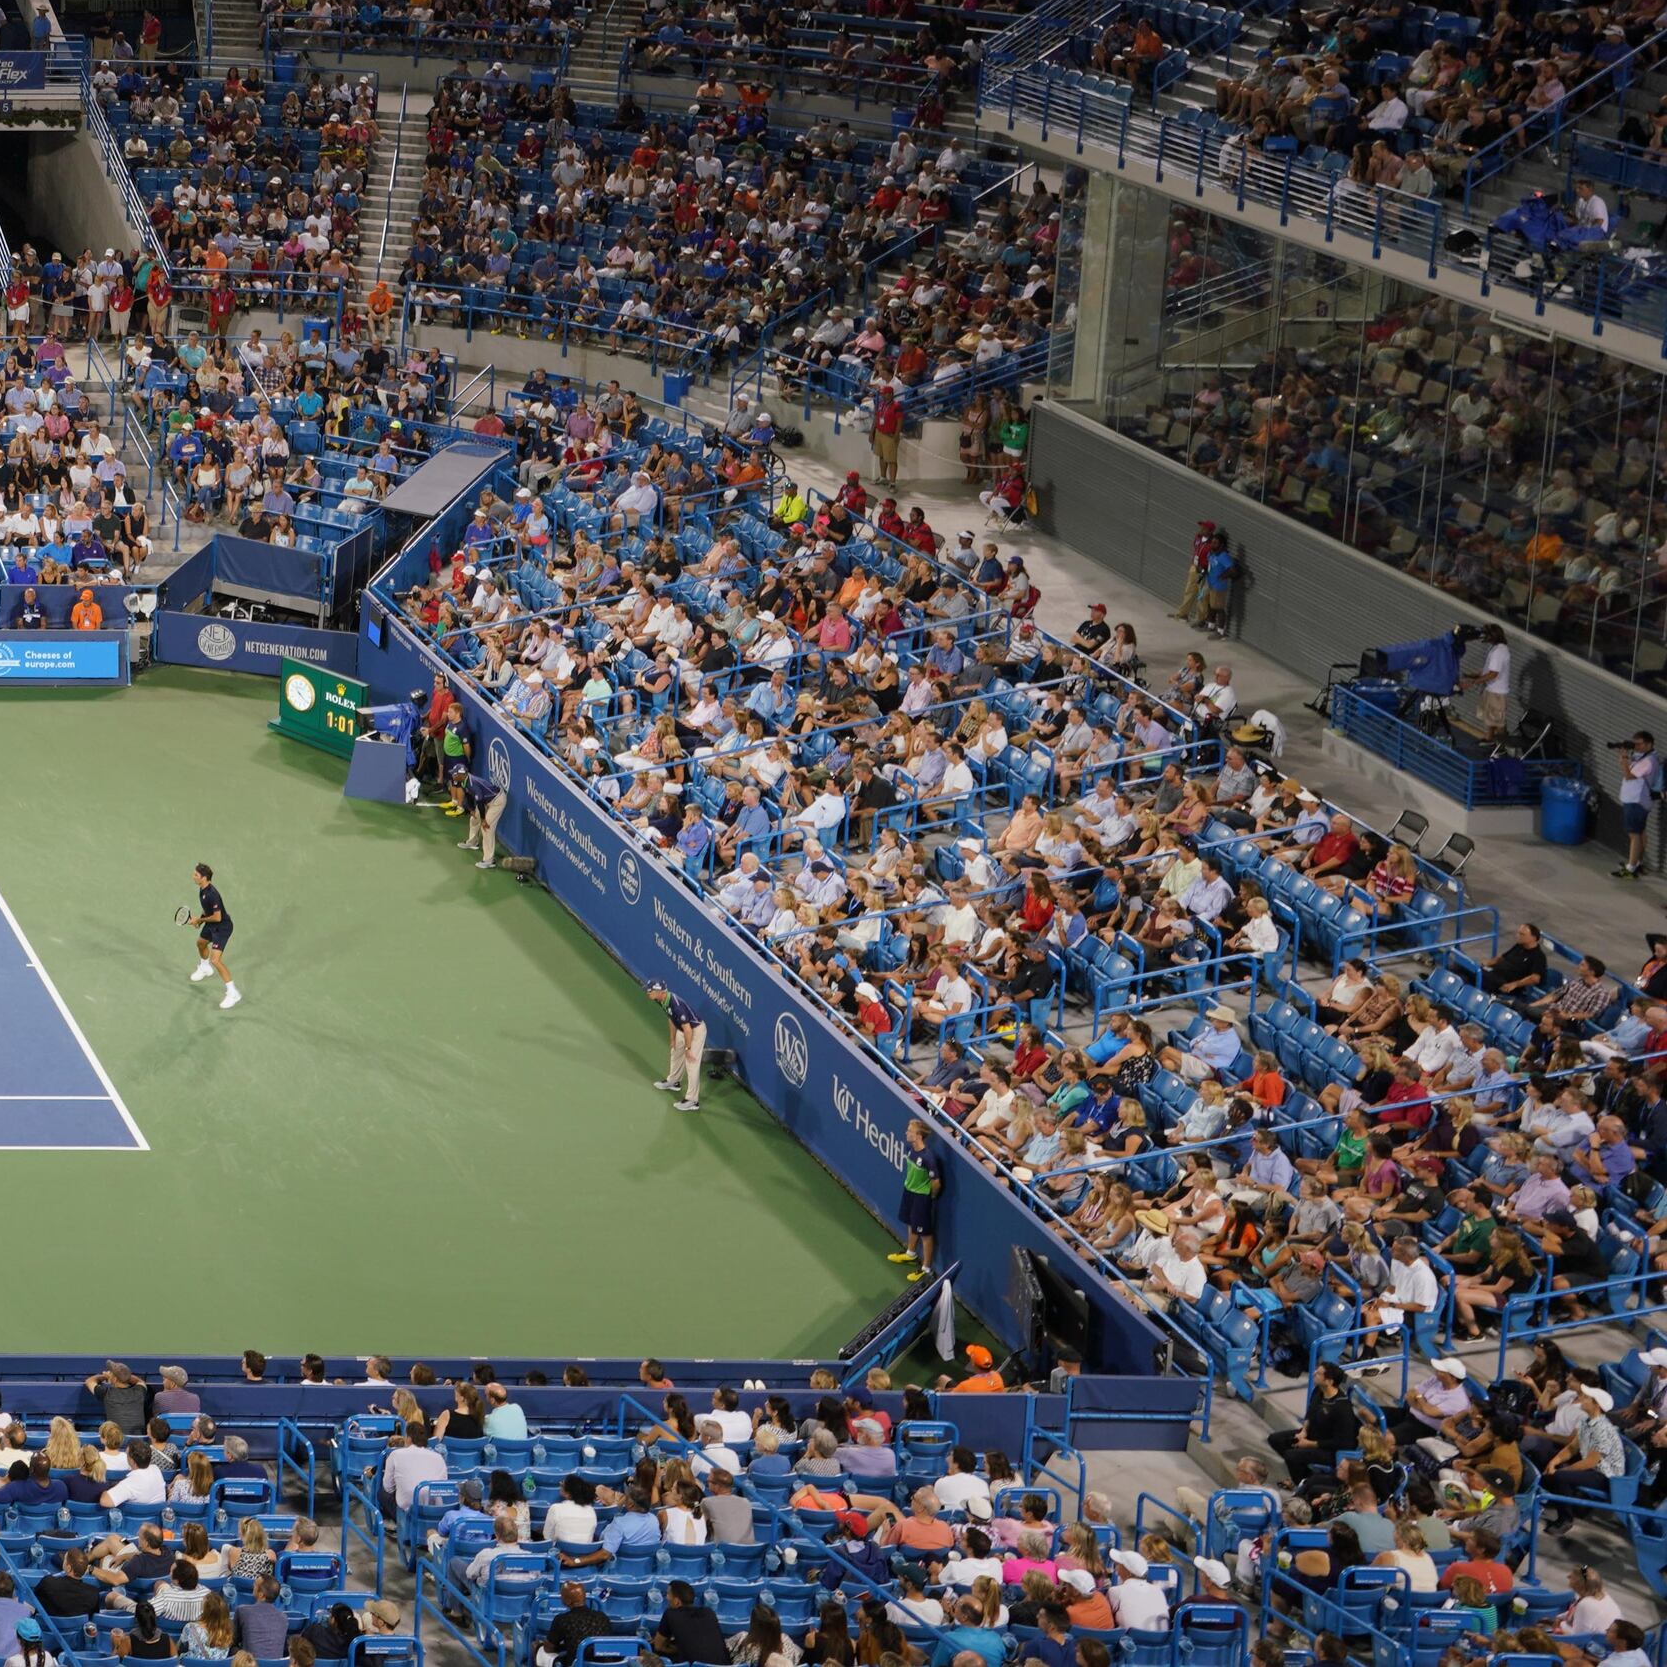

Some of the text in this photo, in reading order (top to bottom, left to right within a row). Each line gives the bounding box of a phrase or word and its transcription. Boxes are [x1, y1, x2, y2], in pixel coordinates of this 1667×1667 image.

[2, 102, 9, 112] 5
[203, 624, 231, 641] NET
[25, 650, 72, 659] Cheeses of
[245, 640, 327, 661] NETGENERATION.COM
[25, 661, 75, 669] europe.com
[325, 692, 356, 711] ROLEX
[327, 711, 354, 736] 1:01
[525, 775, 607, 870] Western & Southern
[653, 896, 752, 1009] Western & Southern
[855, 1101, 909, 1172] Health
